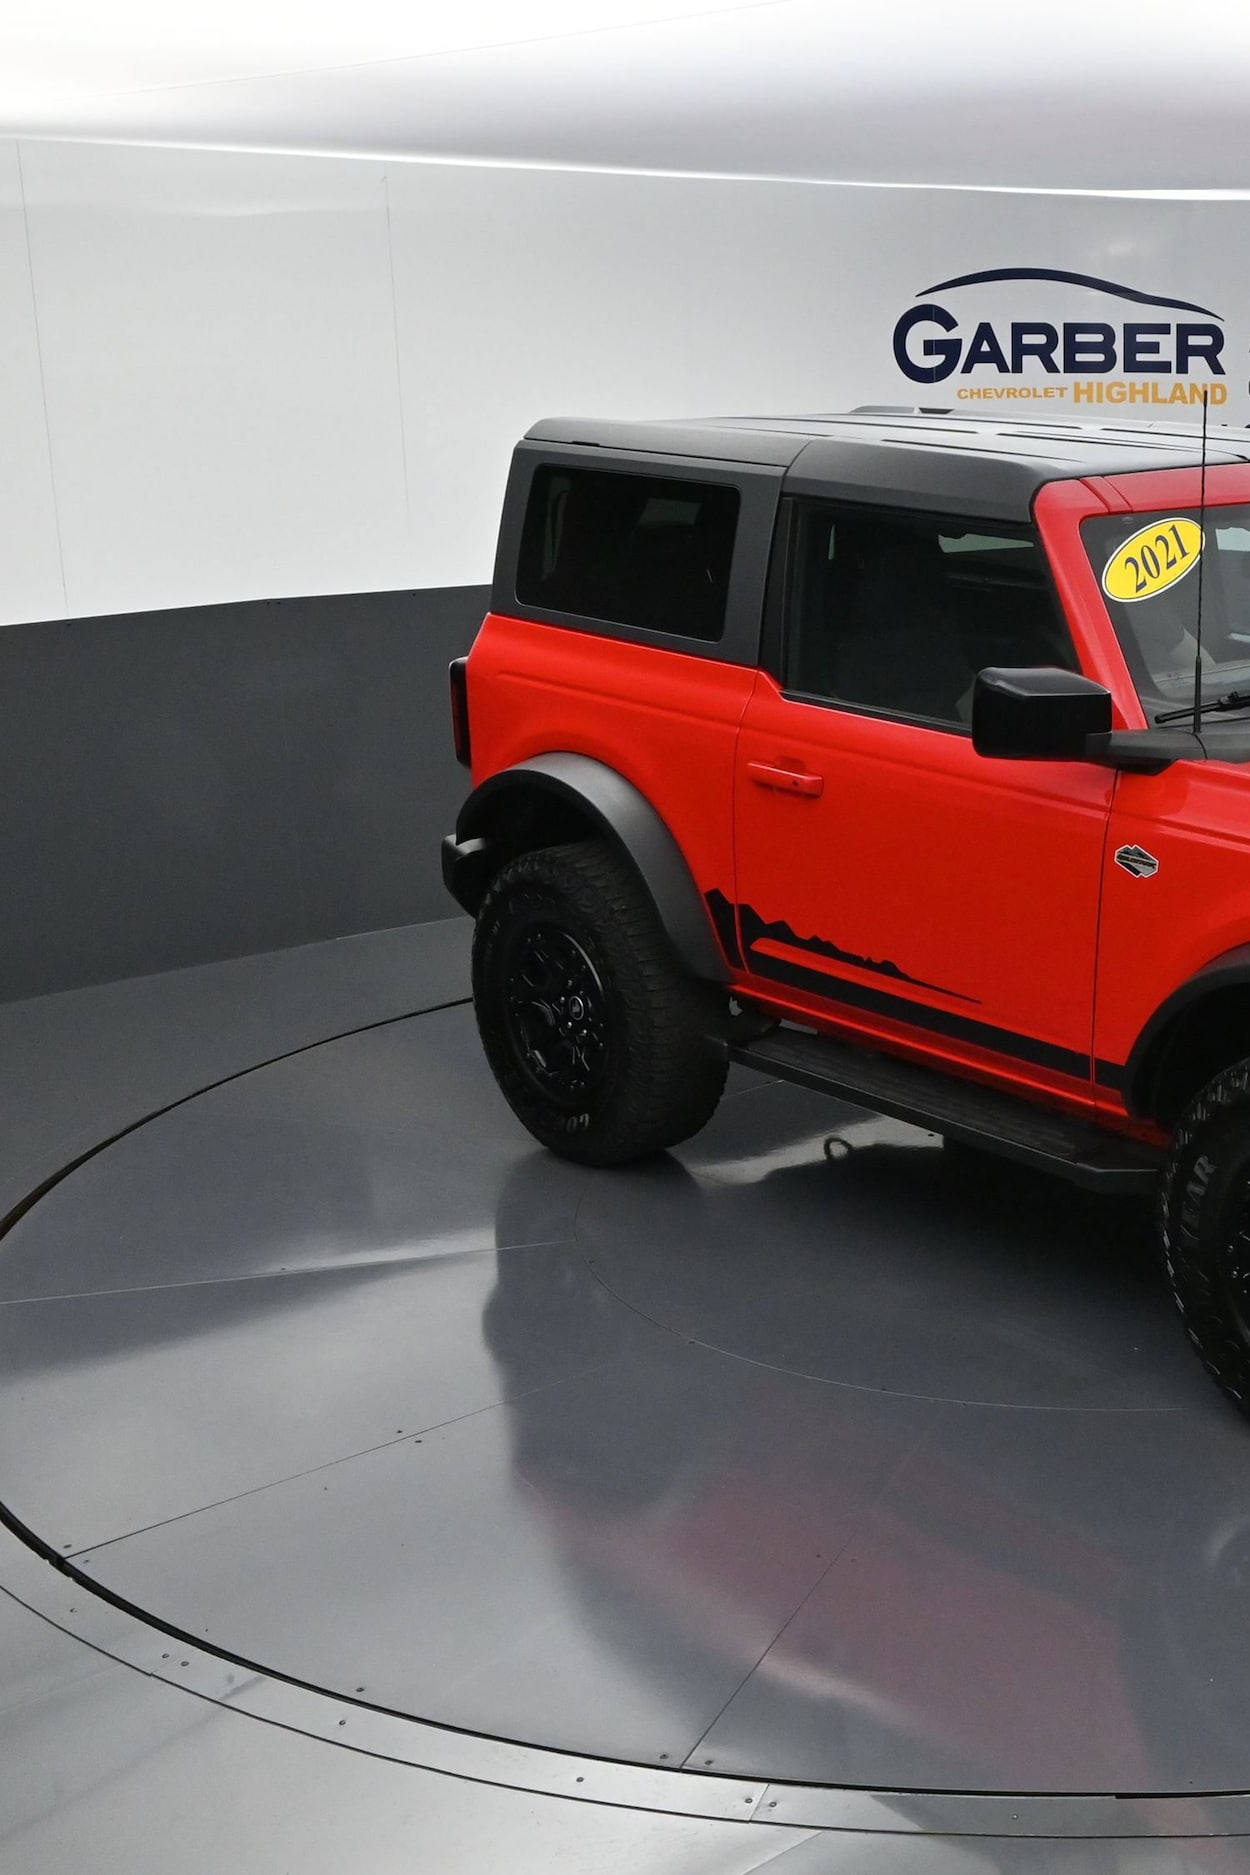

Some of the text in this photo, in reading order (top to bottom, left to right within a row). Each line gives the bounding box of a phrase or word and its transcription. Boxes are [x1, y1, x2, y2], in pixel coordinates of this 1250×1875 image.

[893, 304, 1226, 383] GARBER
[957, 381, 1228, 405] CHEVROLET HIGHLAND
[1125, 524, 1190, 593] 2021
